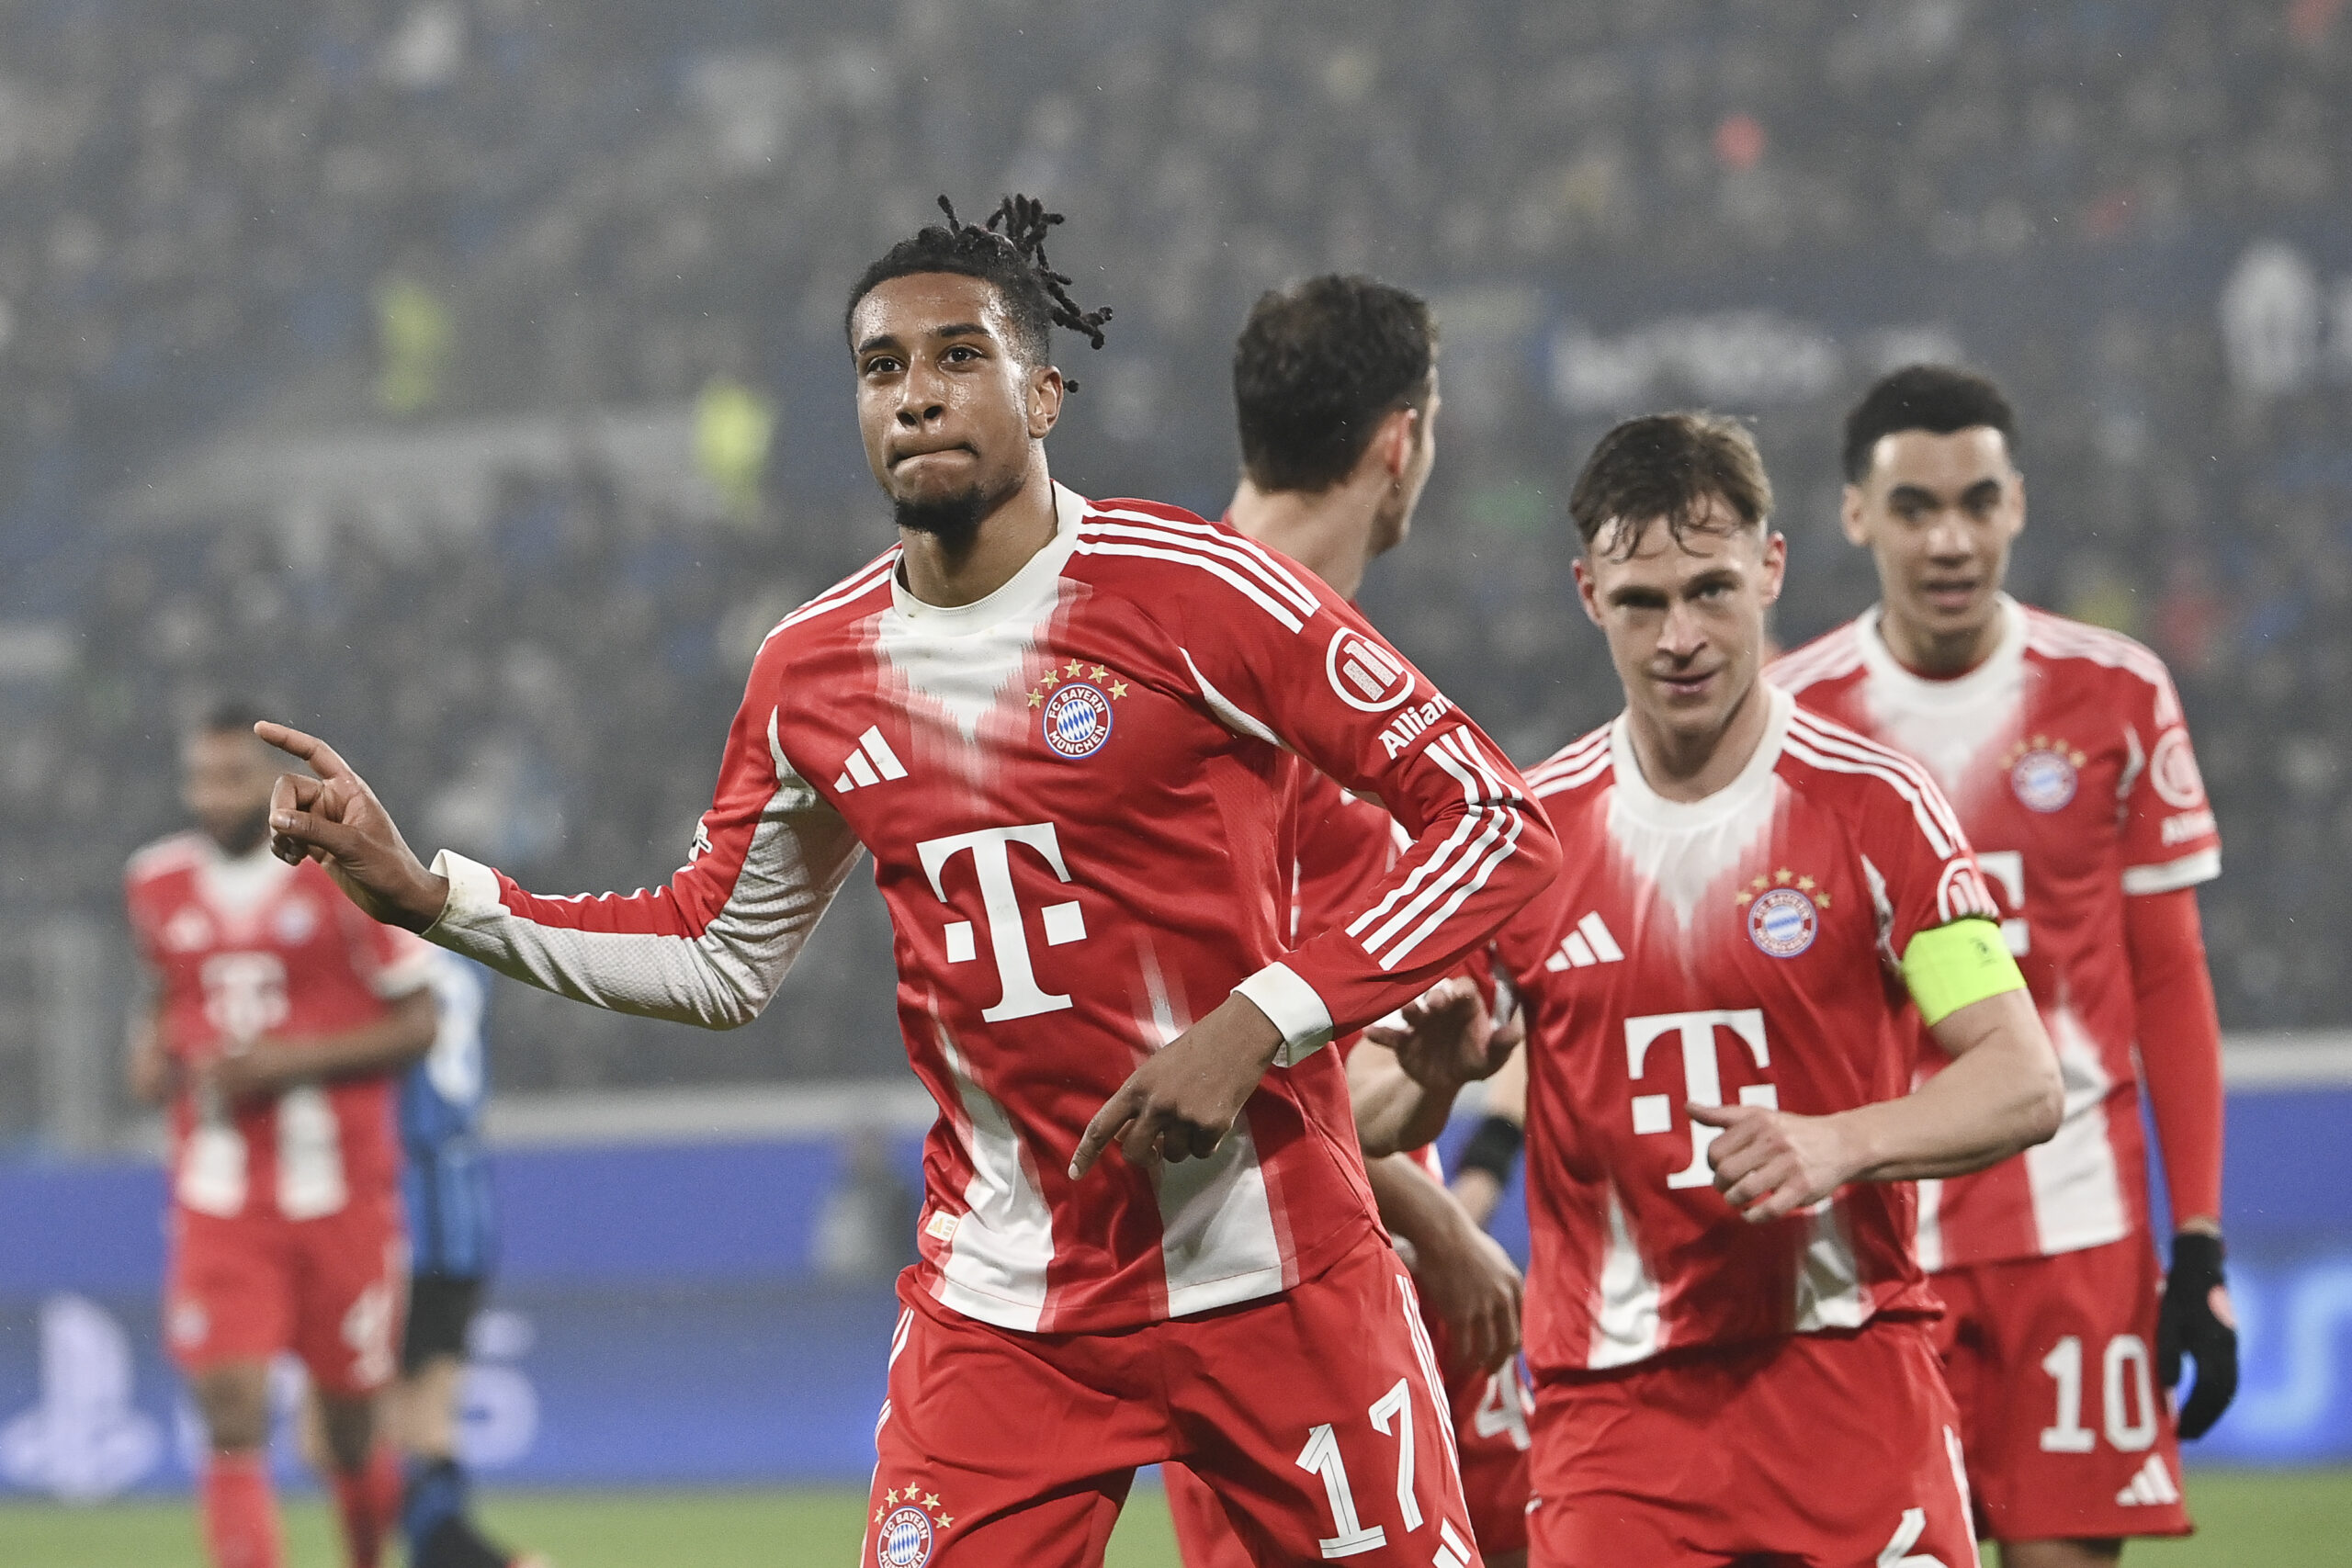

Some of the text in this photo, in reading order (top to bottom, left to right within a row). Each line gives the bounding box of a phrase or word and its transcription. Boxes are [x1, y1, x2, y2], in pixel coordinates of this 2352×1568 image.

[1048, 689, 1105, 718] FC BAYERN
[1378, 693, 1453, 760] Allian
[916, 822, 1073, 1022] T
[1475, 1355, 1532, 1451] 4
[2040, 1335, 2157, 1452] 10
[1295, 1378, 1424, 1559] 17
[896, 1512, 928, 1540] BAYERN
